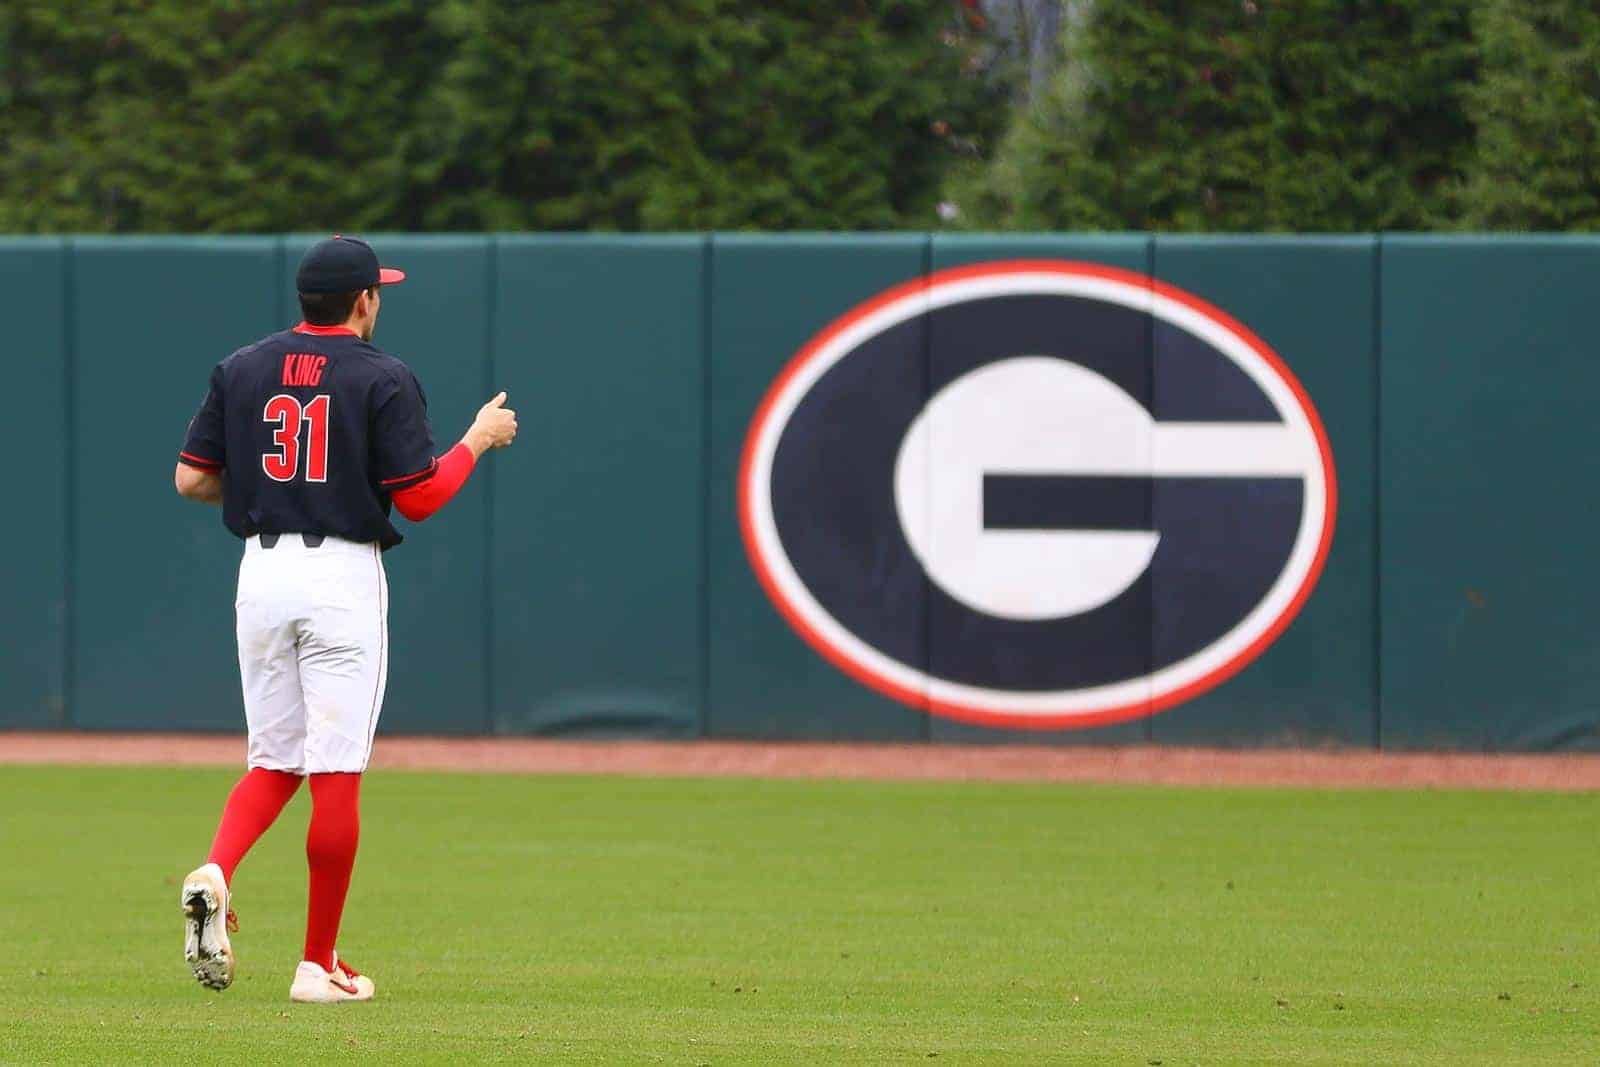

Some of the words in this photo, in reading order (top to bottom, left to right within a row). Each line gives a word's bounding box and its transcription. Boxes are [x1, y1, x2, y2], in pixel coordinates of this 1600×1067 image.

[282, 353, 328, 386] KING
[262, 394, 330, 482] 31
[769, 293, 1305, 692] G
